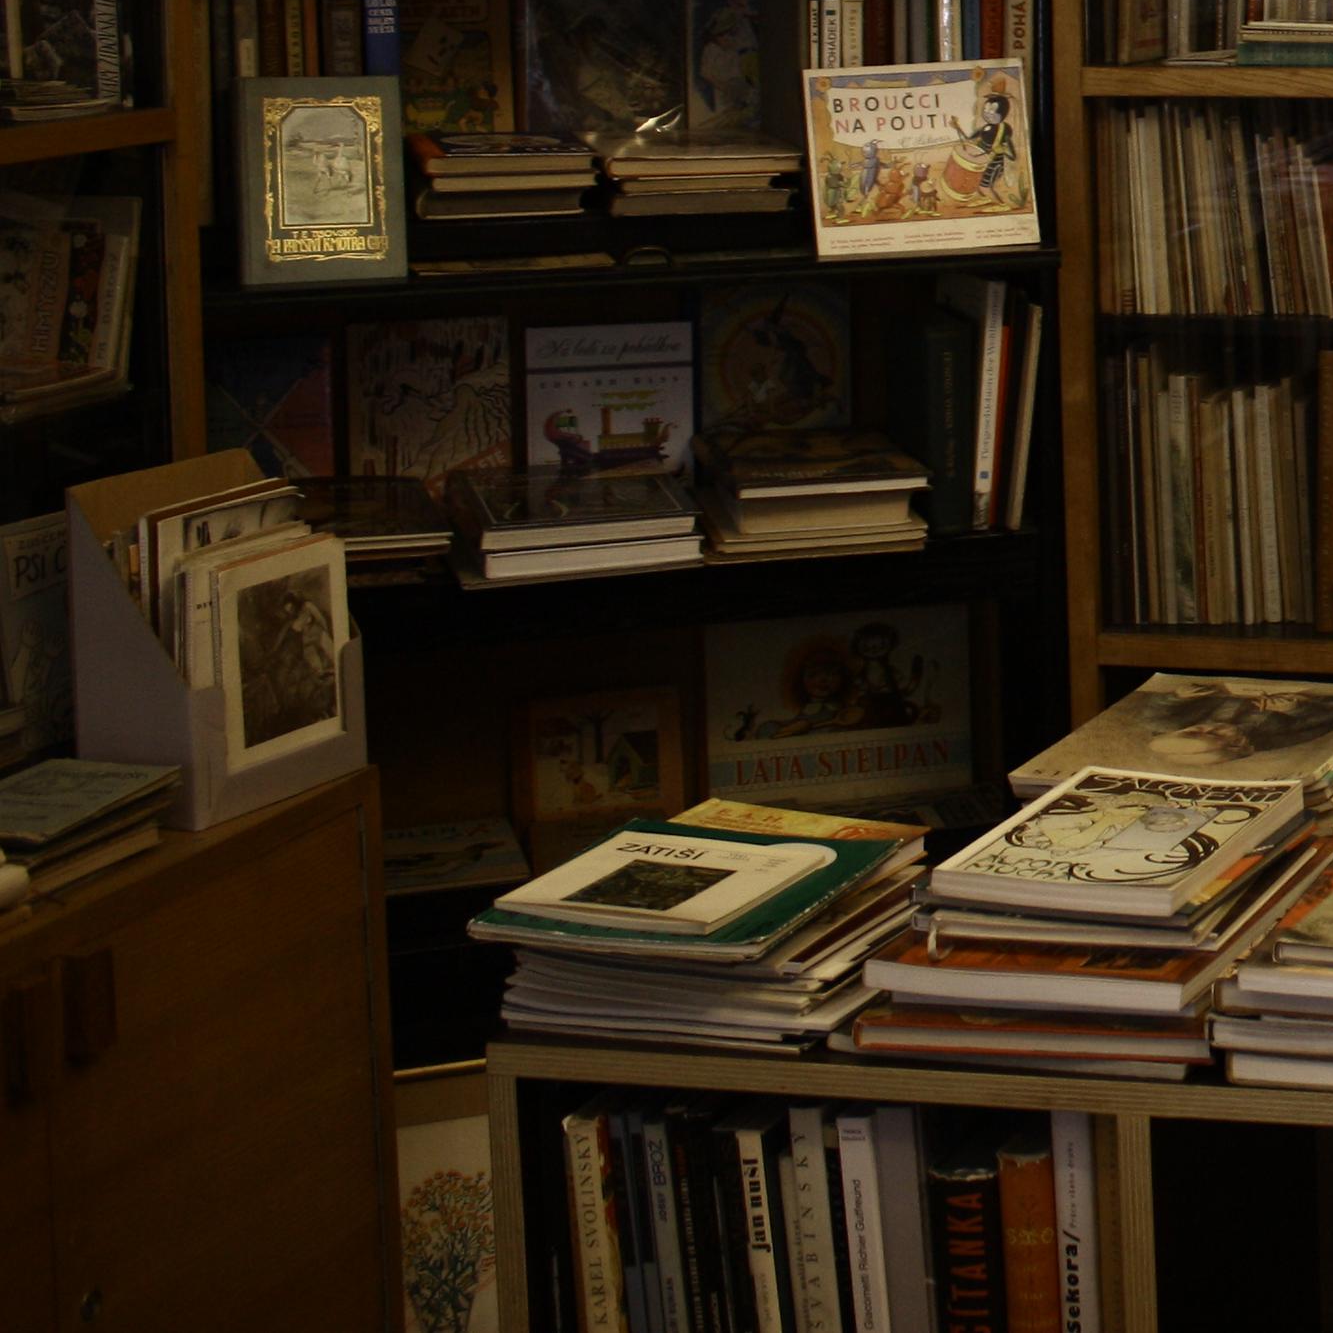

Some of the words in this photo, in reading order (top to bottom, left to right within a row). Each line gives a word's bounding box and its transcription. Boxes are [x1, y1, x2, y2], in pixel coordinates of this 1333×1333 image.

[832, 93, 940, 113] BROUČCI
[835, 117, 866, 135] NA
[573, 1133, 599, 1249] SVOLINSKÝ
[750, 1215, 772, 1253] jan
[588, 1257, 608, 1325] KAREL
